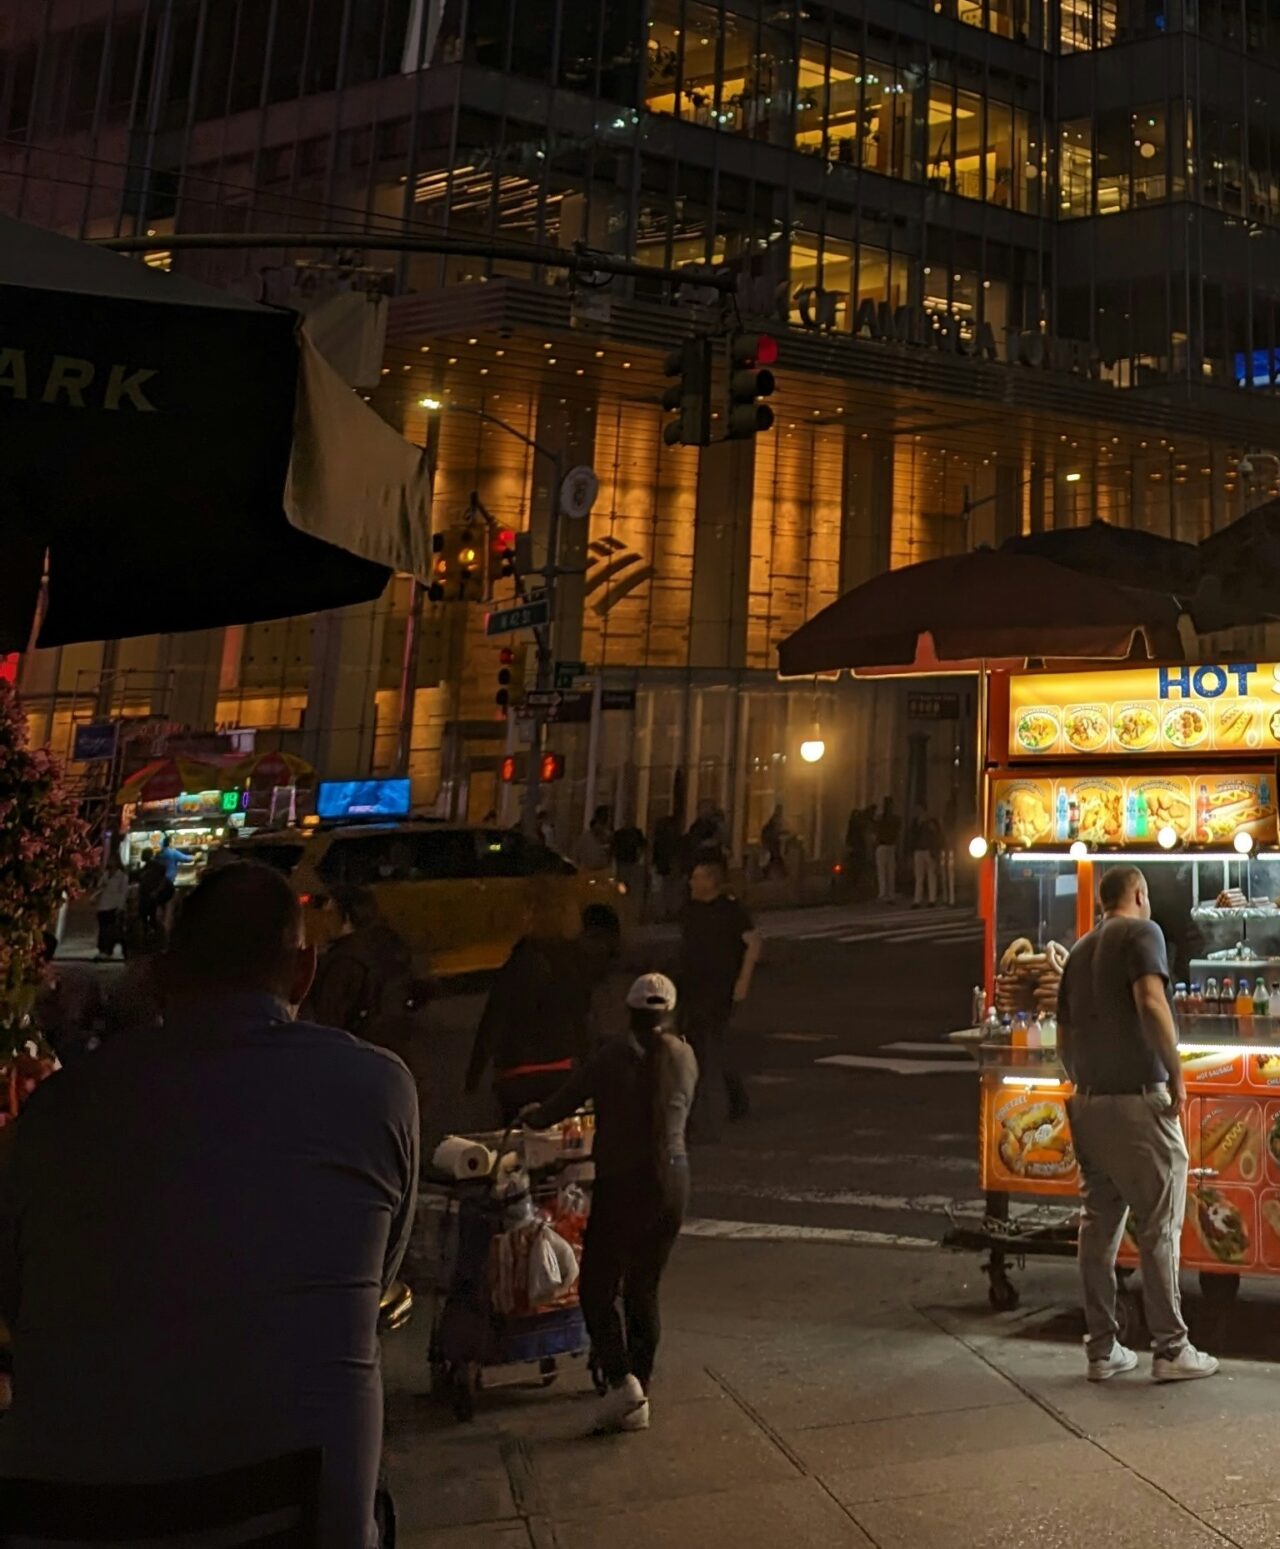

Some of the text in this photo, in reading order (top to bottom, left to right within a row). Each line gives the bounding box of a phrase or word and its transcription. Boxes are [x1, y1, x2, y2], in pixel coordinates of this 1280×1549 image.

[0, 347, 160, 412] ARK
[1158, 663, 1258, 699] HOT
[1196, 1065, 1234, 1081] HOT SAUSAGE
